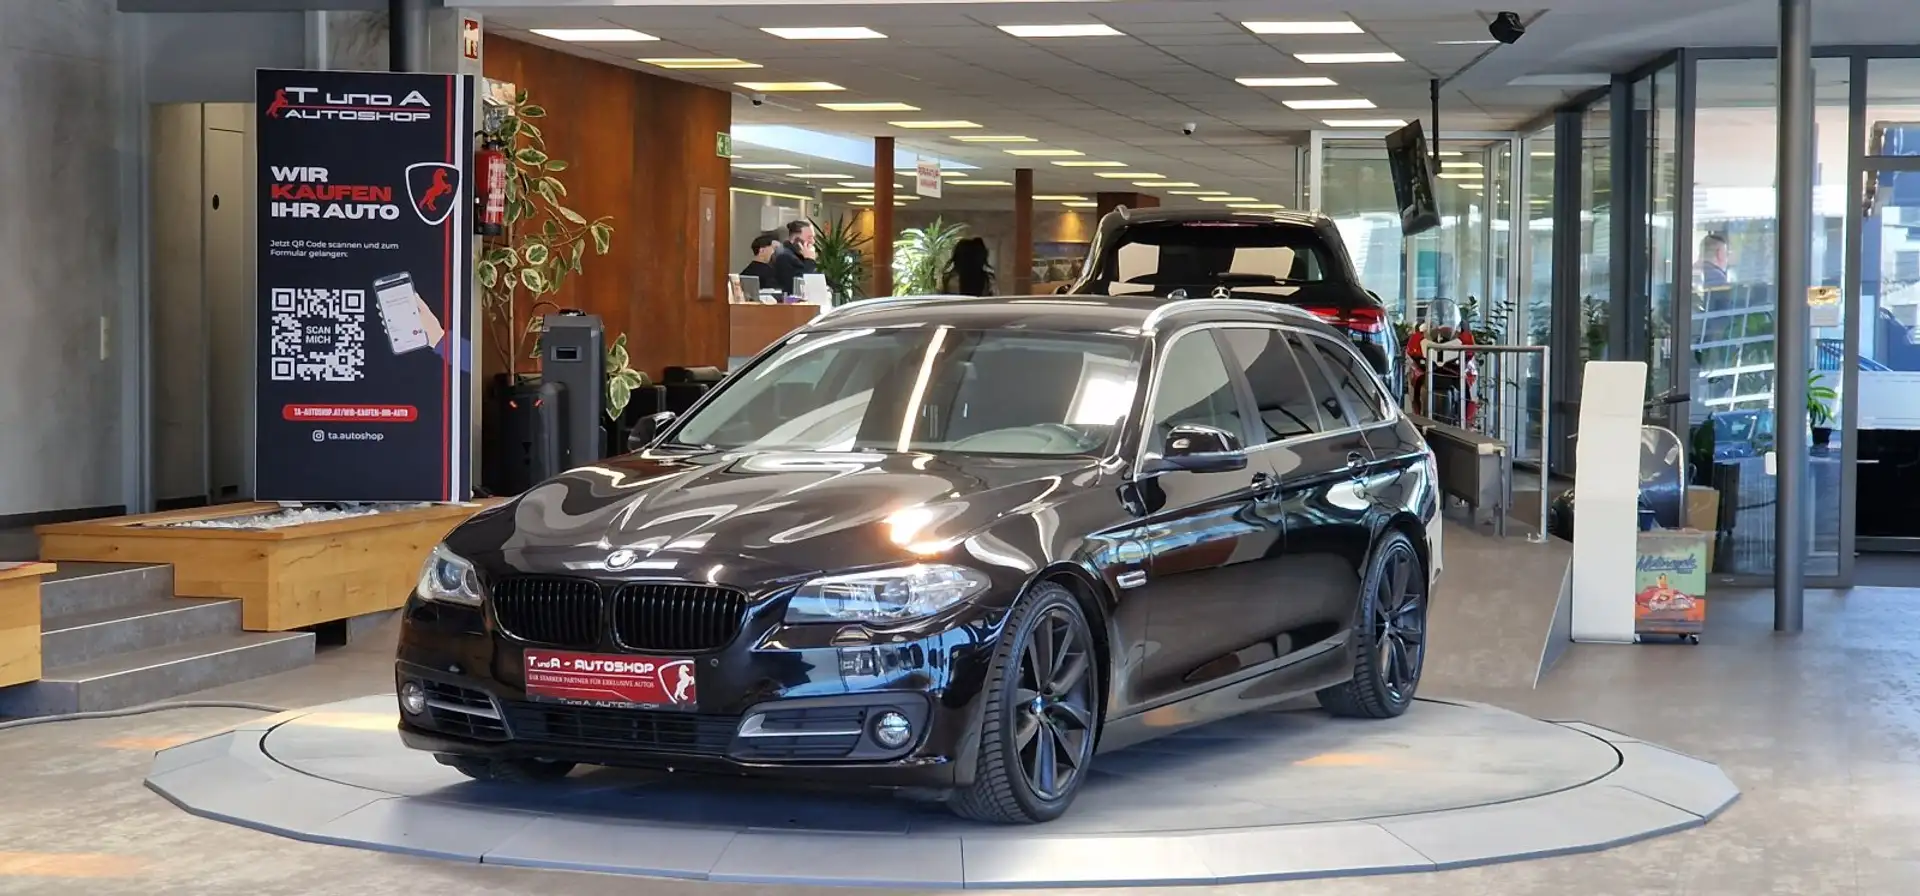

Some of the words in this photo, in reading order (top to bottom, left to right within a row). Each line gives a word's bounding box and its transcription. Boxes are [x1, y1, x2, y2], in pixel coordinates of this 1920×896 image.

[285, 87, 318, 103] T
[399, 90, 431, 107] A
[285, 109, 431, 122] AUTOSHOP
[270, 166, 328, 182] WIR
[271, 184, 392, 202] KAUFEN
[271, 202, 320, 218] IHR
[322, 203, 399, 220] AUTO
[291, 240, 304, 248] QR
[306, 240, 326, 248] Code
[328, 241, 362, 249] scannen
[270, 249, 307, 257] Formular
[308, 250, 348, 259] gelangen:
[306, 326, 331, 334] SCAN
[306, 335, 331, 344] MICH
[328, 431, 384, 441] ta.autoshop
[575, 659, 655, 674] AUTOSHOP
